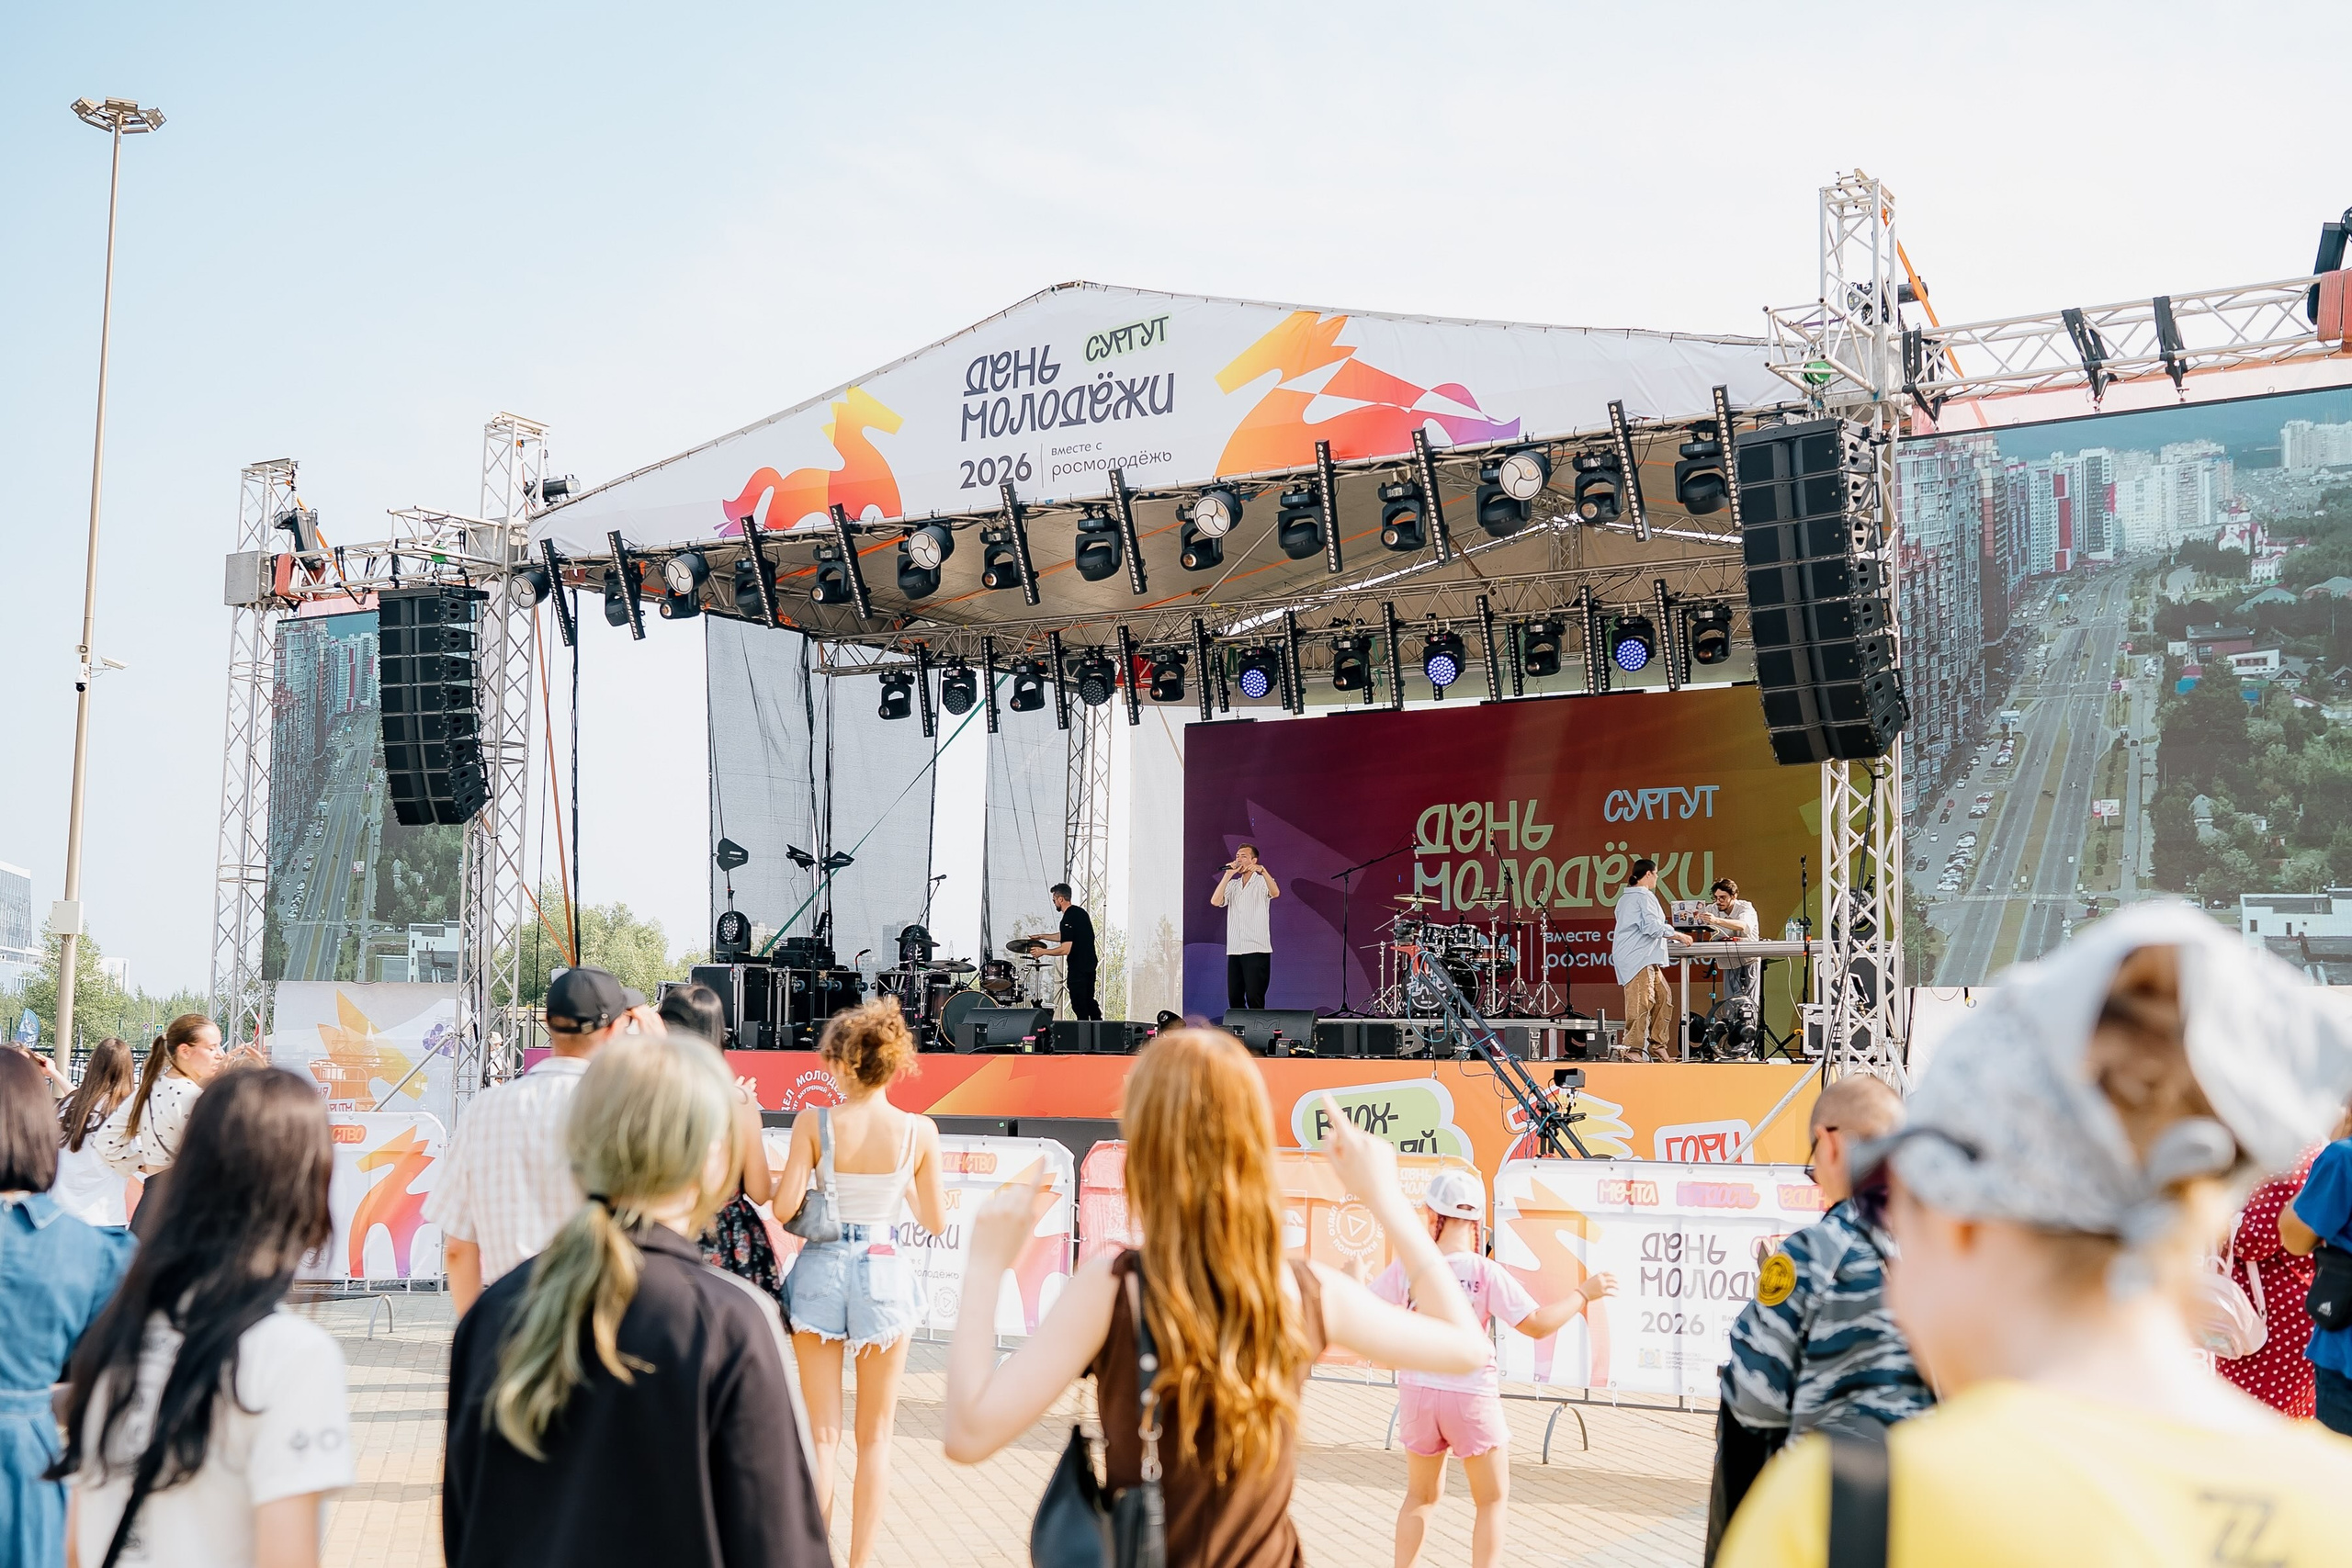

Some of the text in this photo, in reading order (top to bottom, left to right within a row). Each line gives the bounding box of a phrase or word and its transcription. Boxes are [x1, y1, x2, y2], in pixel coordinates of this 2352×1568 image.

[1085, 315, 1170, 362] СУРГУТ
[1051, 442, 1102, 457] вместе с
[1051, 449, 1172, 482] росмолодёжь
[959, 453, 1032, 490] 2026
[1603, 784, 1720, 823] СУРГУТ
[1545, 931, 1601, 942] вместе
[330, 1127, 365, 1142] СТВО
[1640, 1267, 1758, 1303] МОЛОД
[1641, 1311, 1705, 1336] 2026
